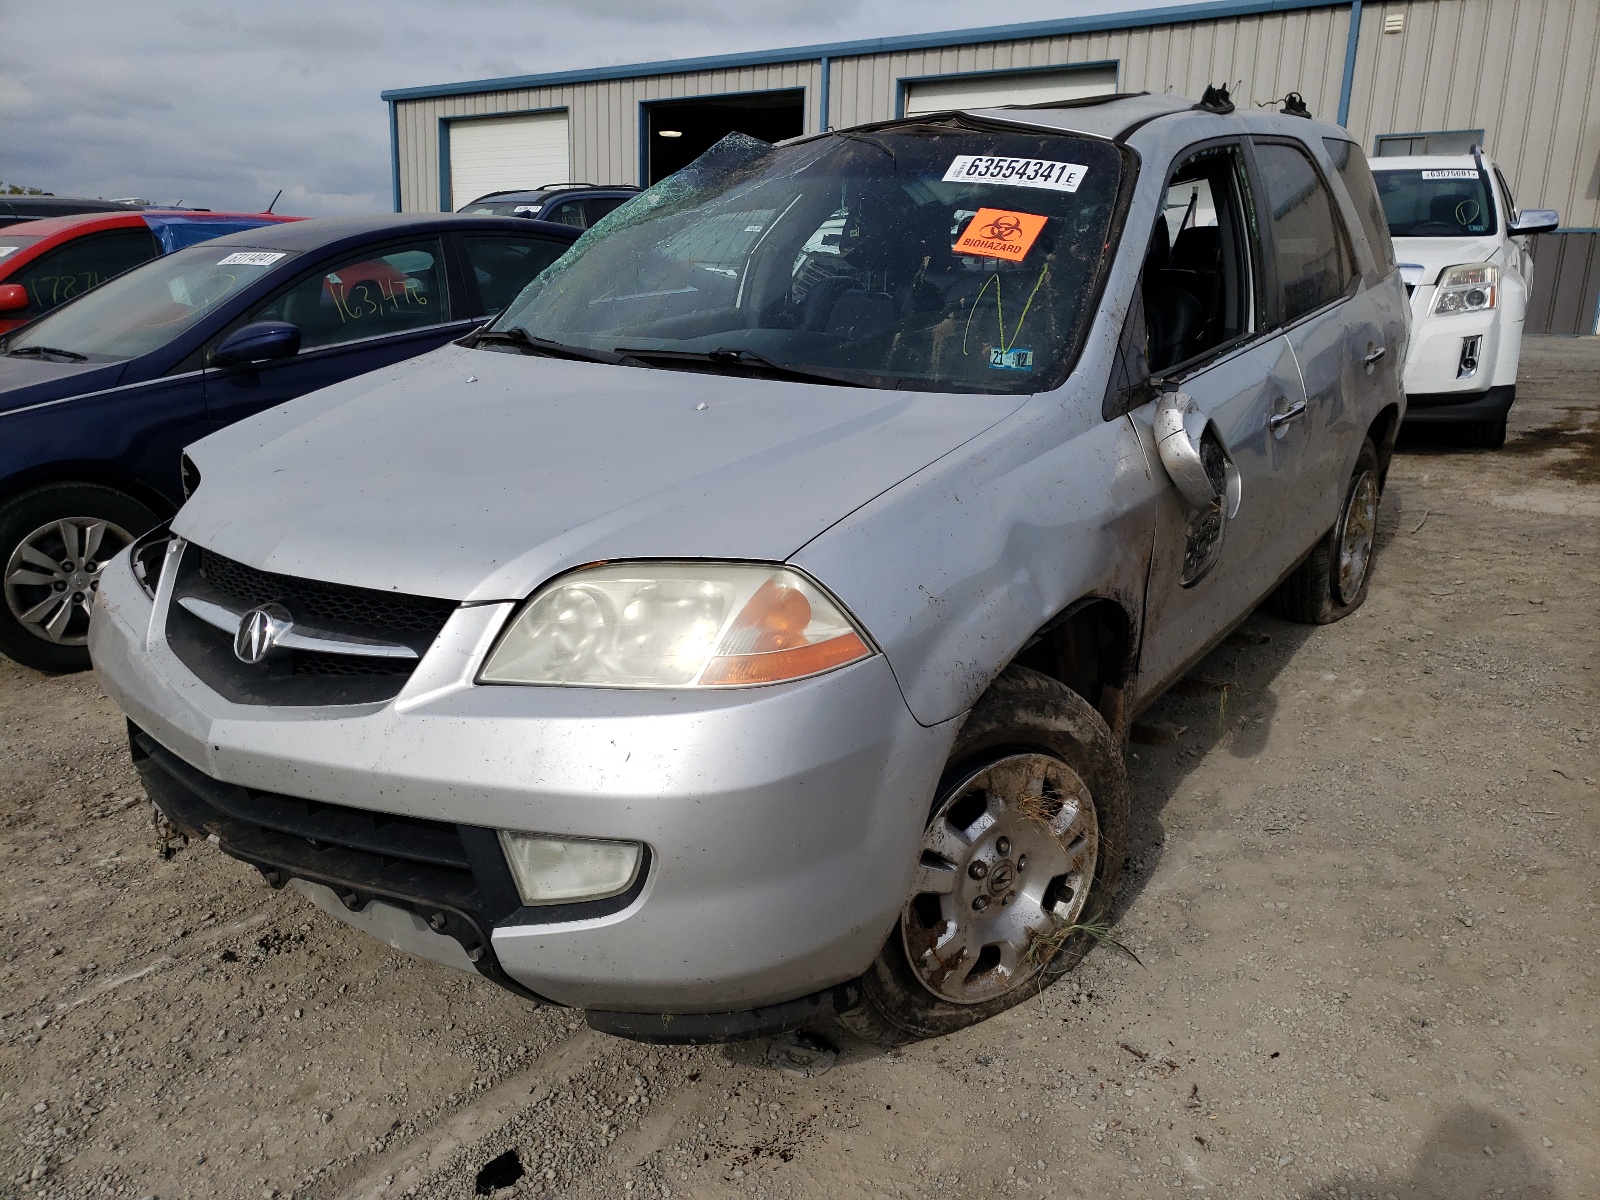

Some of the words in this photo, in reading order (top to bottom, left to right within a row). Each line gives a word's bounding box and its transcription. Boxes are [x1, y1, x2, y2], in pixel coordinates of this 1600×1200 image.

[966, 158, 1067, 183] 63554341
[1067, 172, 1076, 183] E
[962, 238, 1022, 254] BIOHAZARD
[993, 350, 1004, 365] 21
